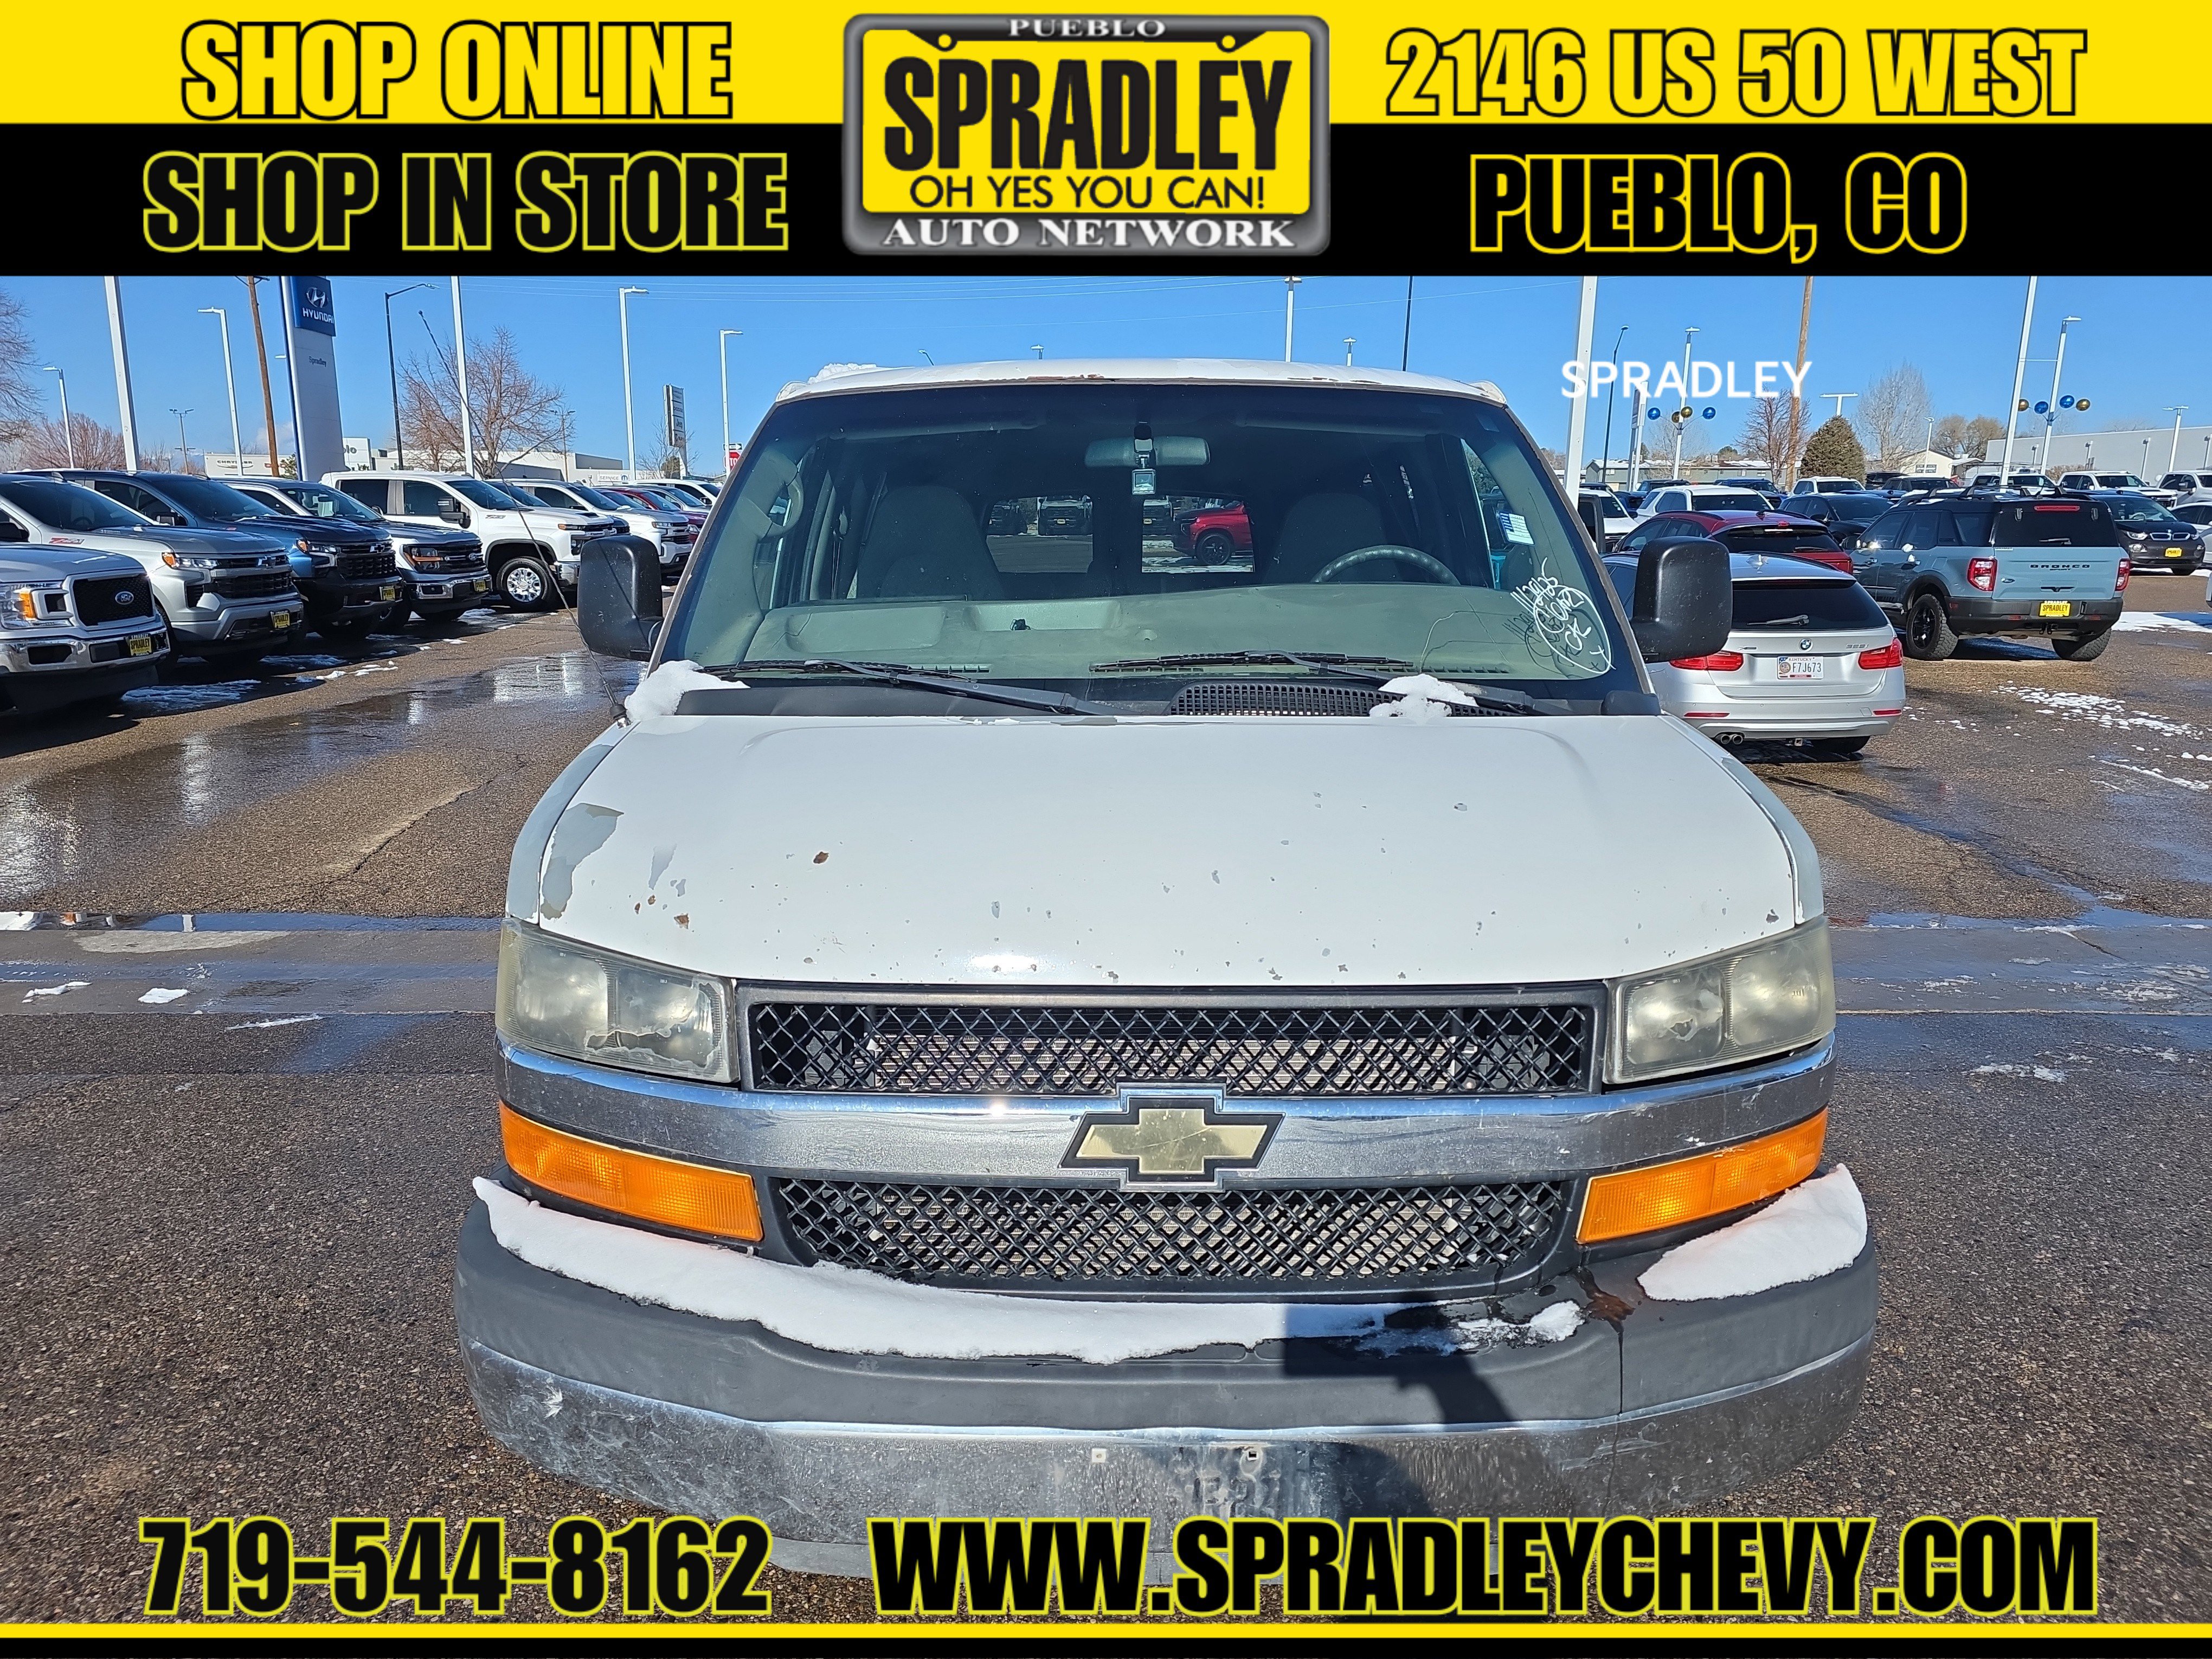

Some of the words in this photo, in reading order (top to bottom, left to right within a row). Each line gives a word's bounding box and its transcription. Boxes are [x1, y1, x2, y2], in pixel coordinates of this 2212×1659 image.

[303, 307, 334, 324] HYUNDAI
[130, 638, 150, 650] SPRADLEY
[1792, 662, 1822, 673] F7J673
